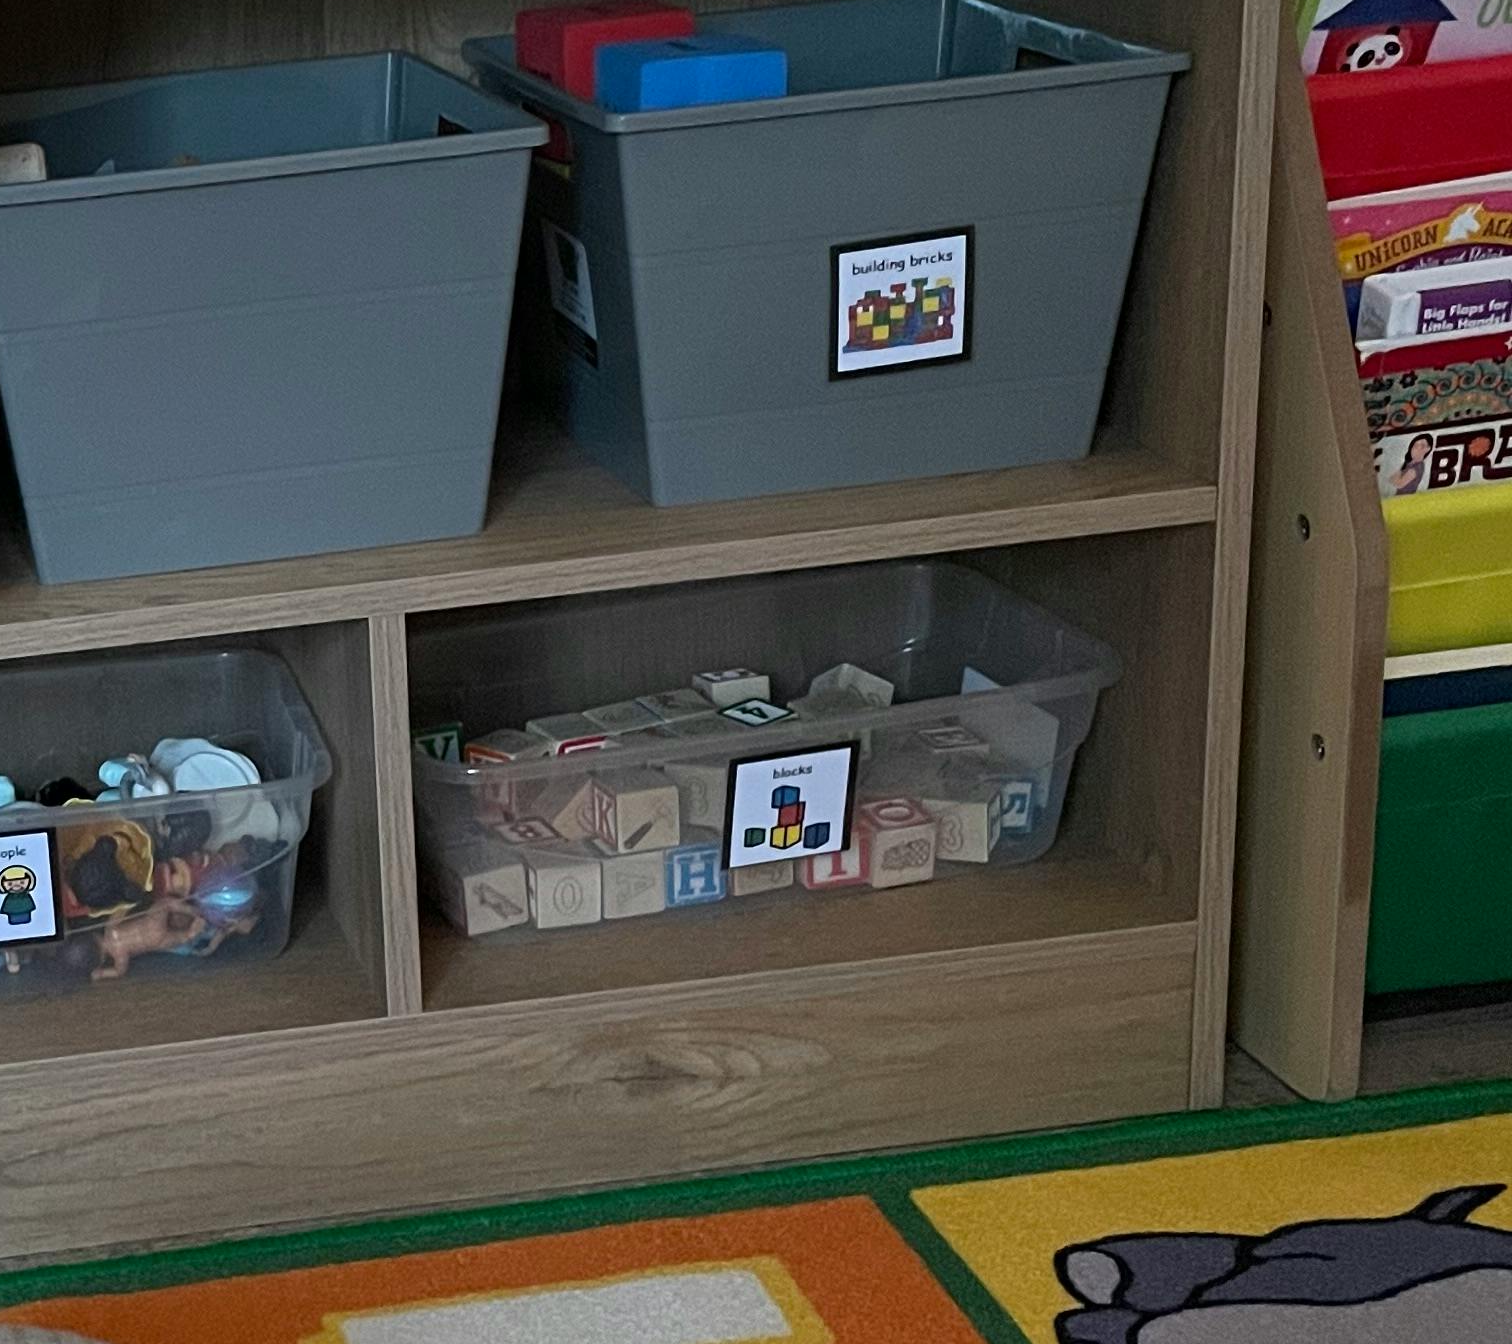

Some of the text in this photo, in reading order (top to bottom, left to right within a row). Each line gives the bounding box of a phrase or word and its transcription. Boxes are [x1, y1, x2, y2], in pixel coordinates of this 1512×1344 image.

[852, 250, 953, 276] building bricks
[1423, 299, 1509, 321] Big Flaps for
[772, 764, 813, 780] blocks
[676, 856, 718, 896] H
